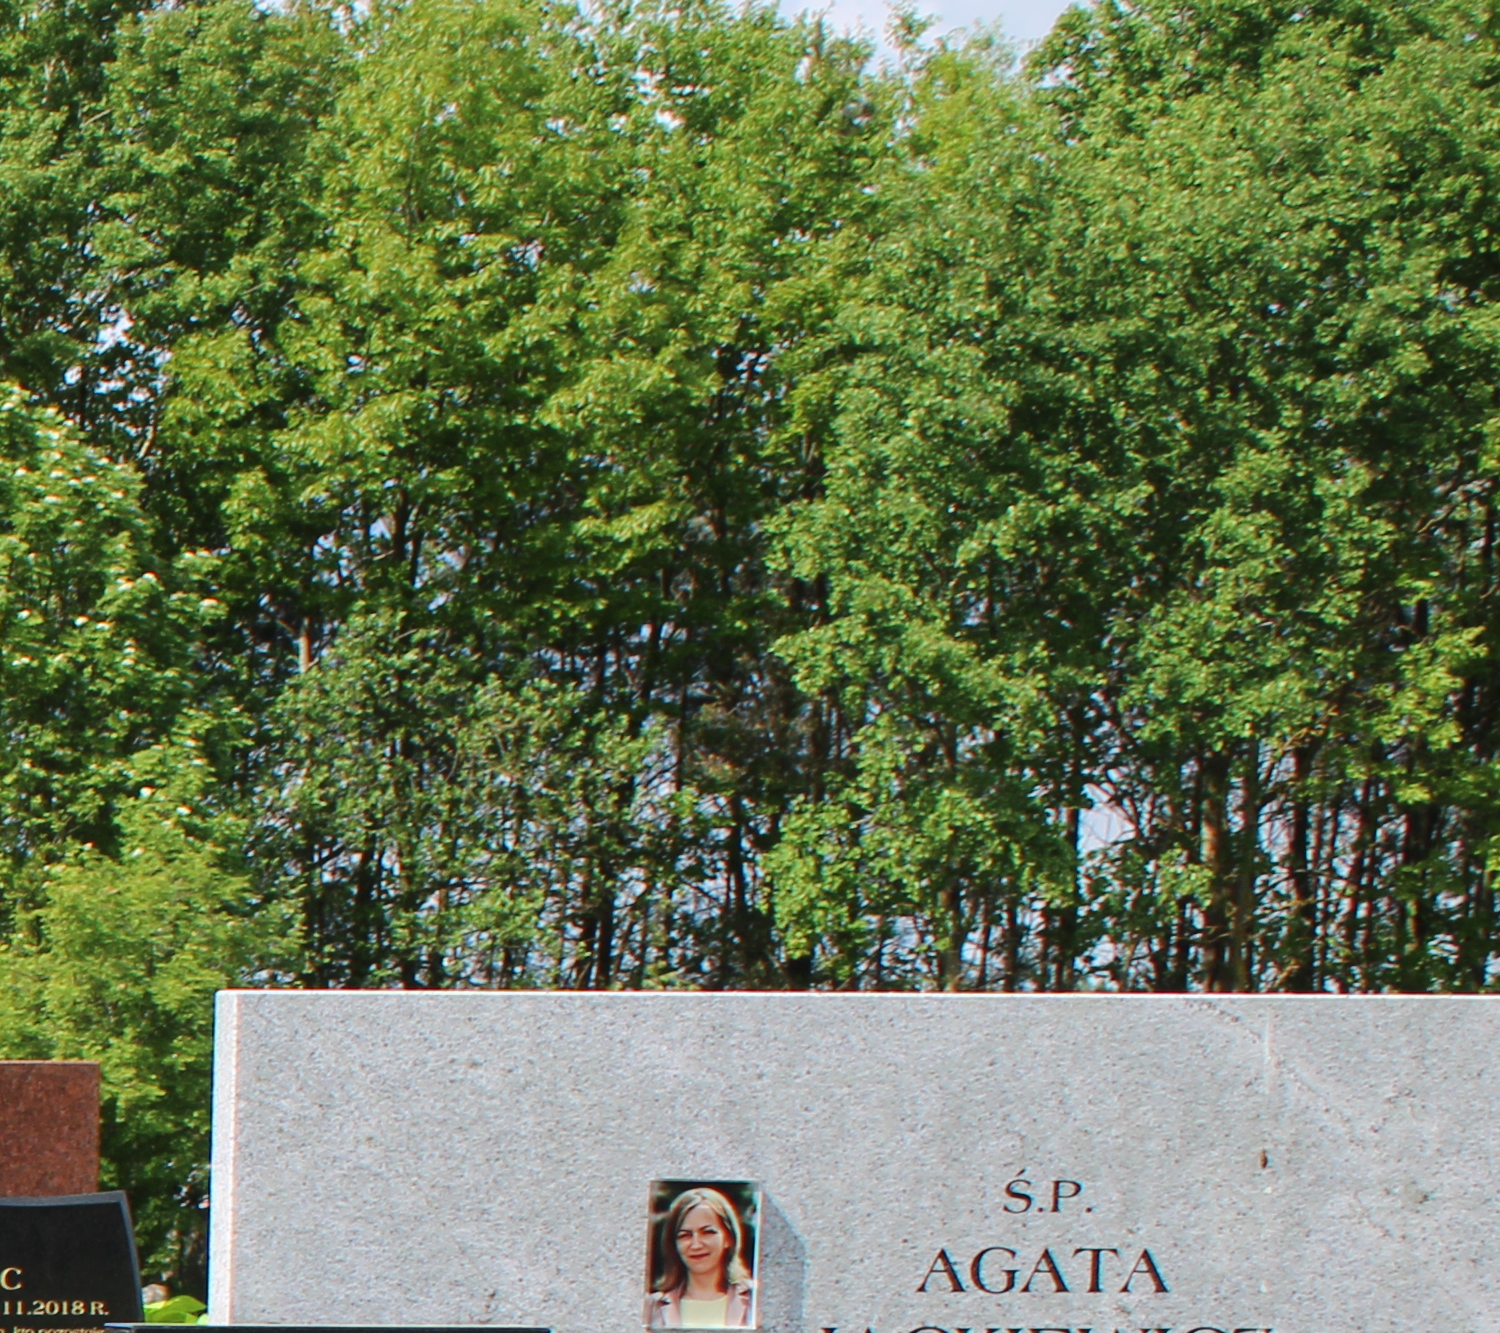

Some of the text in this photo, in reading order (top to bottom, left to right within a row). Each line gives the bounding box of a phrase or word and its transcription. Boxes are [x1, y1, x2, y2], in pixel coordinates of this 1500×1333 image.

[1002, 1168, 1094, 1214] Ś.P.
[916, 1246, 1170, 1294] AGATA
[89, 1300, 110, 1316] R.
